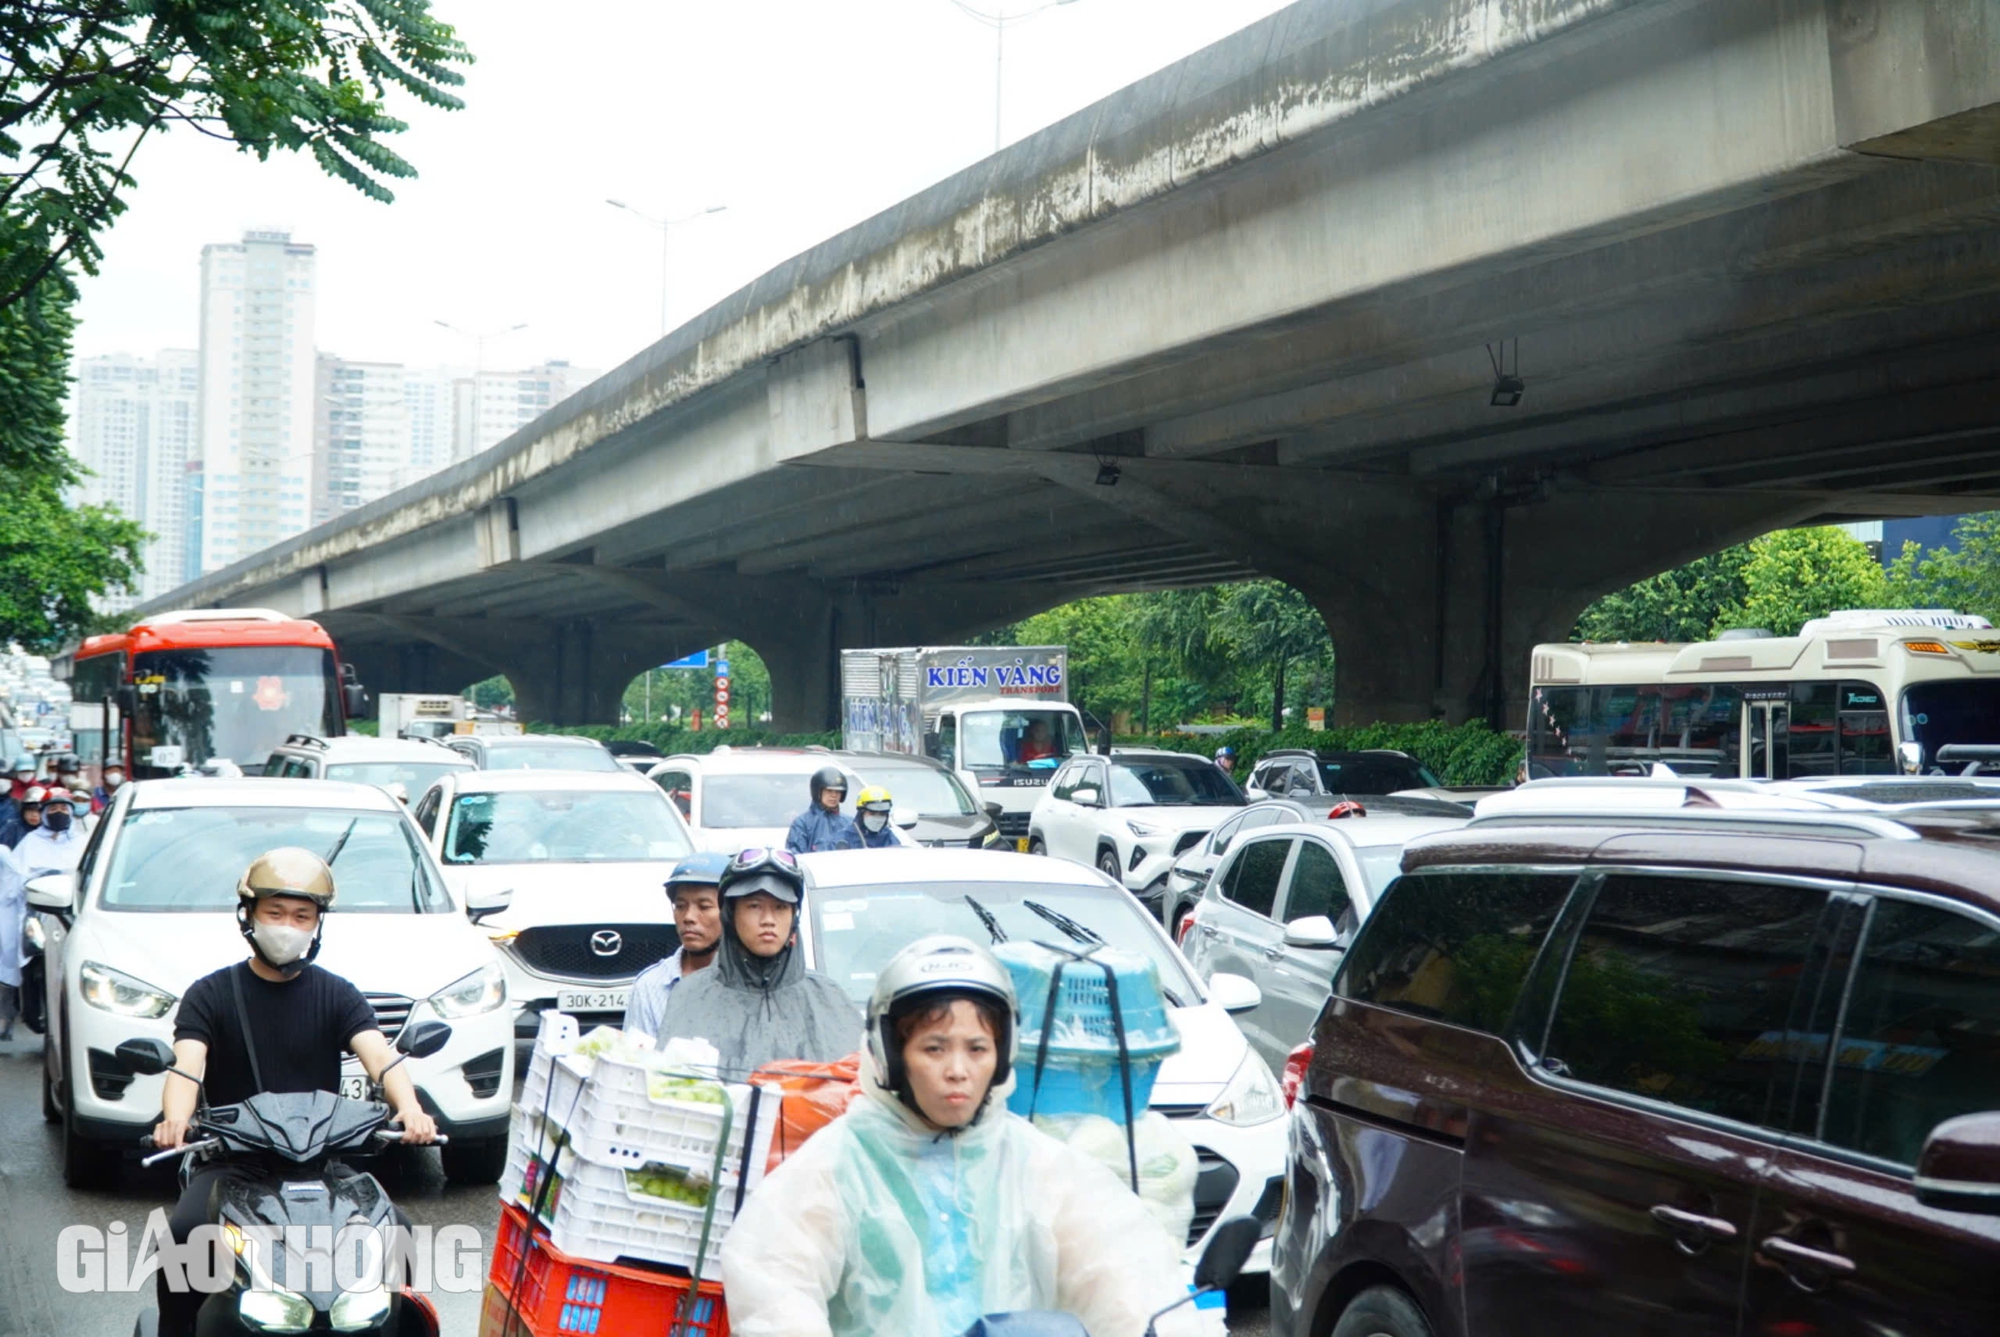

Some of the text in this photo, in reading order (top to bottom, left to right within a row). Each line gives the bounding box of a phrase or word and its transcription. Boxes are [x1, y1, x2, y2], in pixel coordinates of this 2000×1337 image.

[927, 656, 1062, 687] KIẾN VÀNG
[999, 685, 1062, 695] TRANSPORT
[1013, 778, 1048, 786] ISUZU
[340, 1078, 363, 1100] 43
